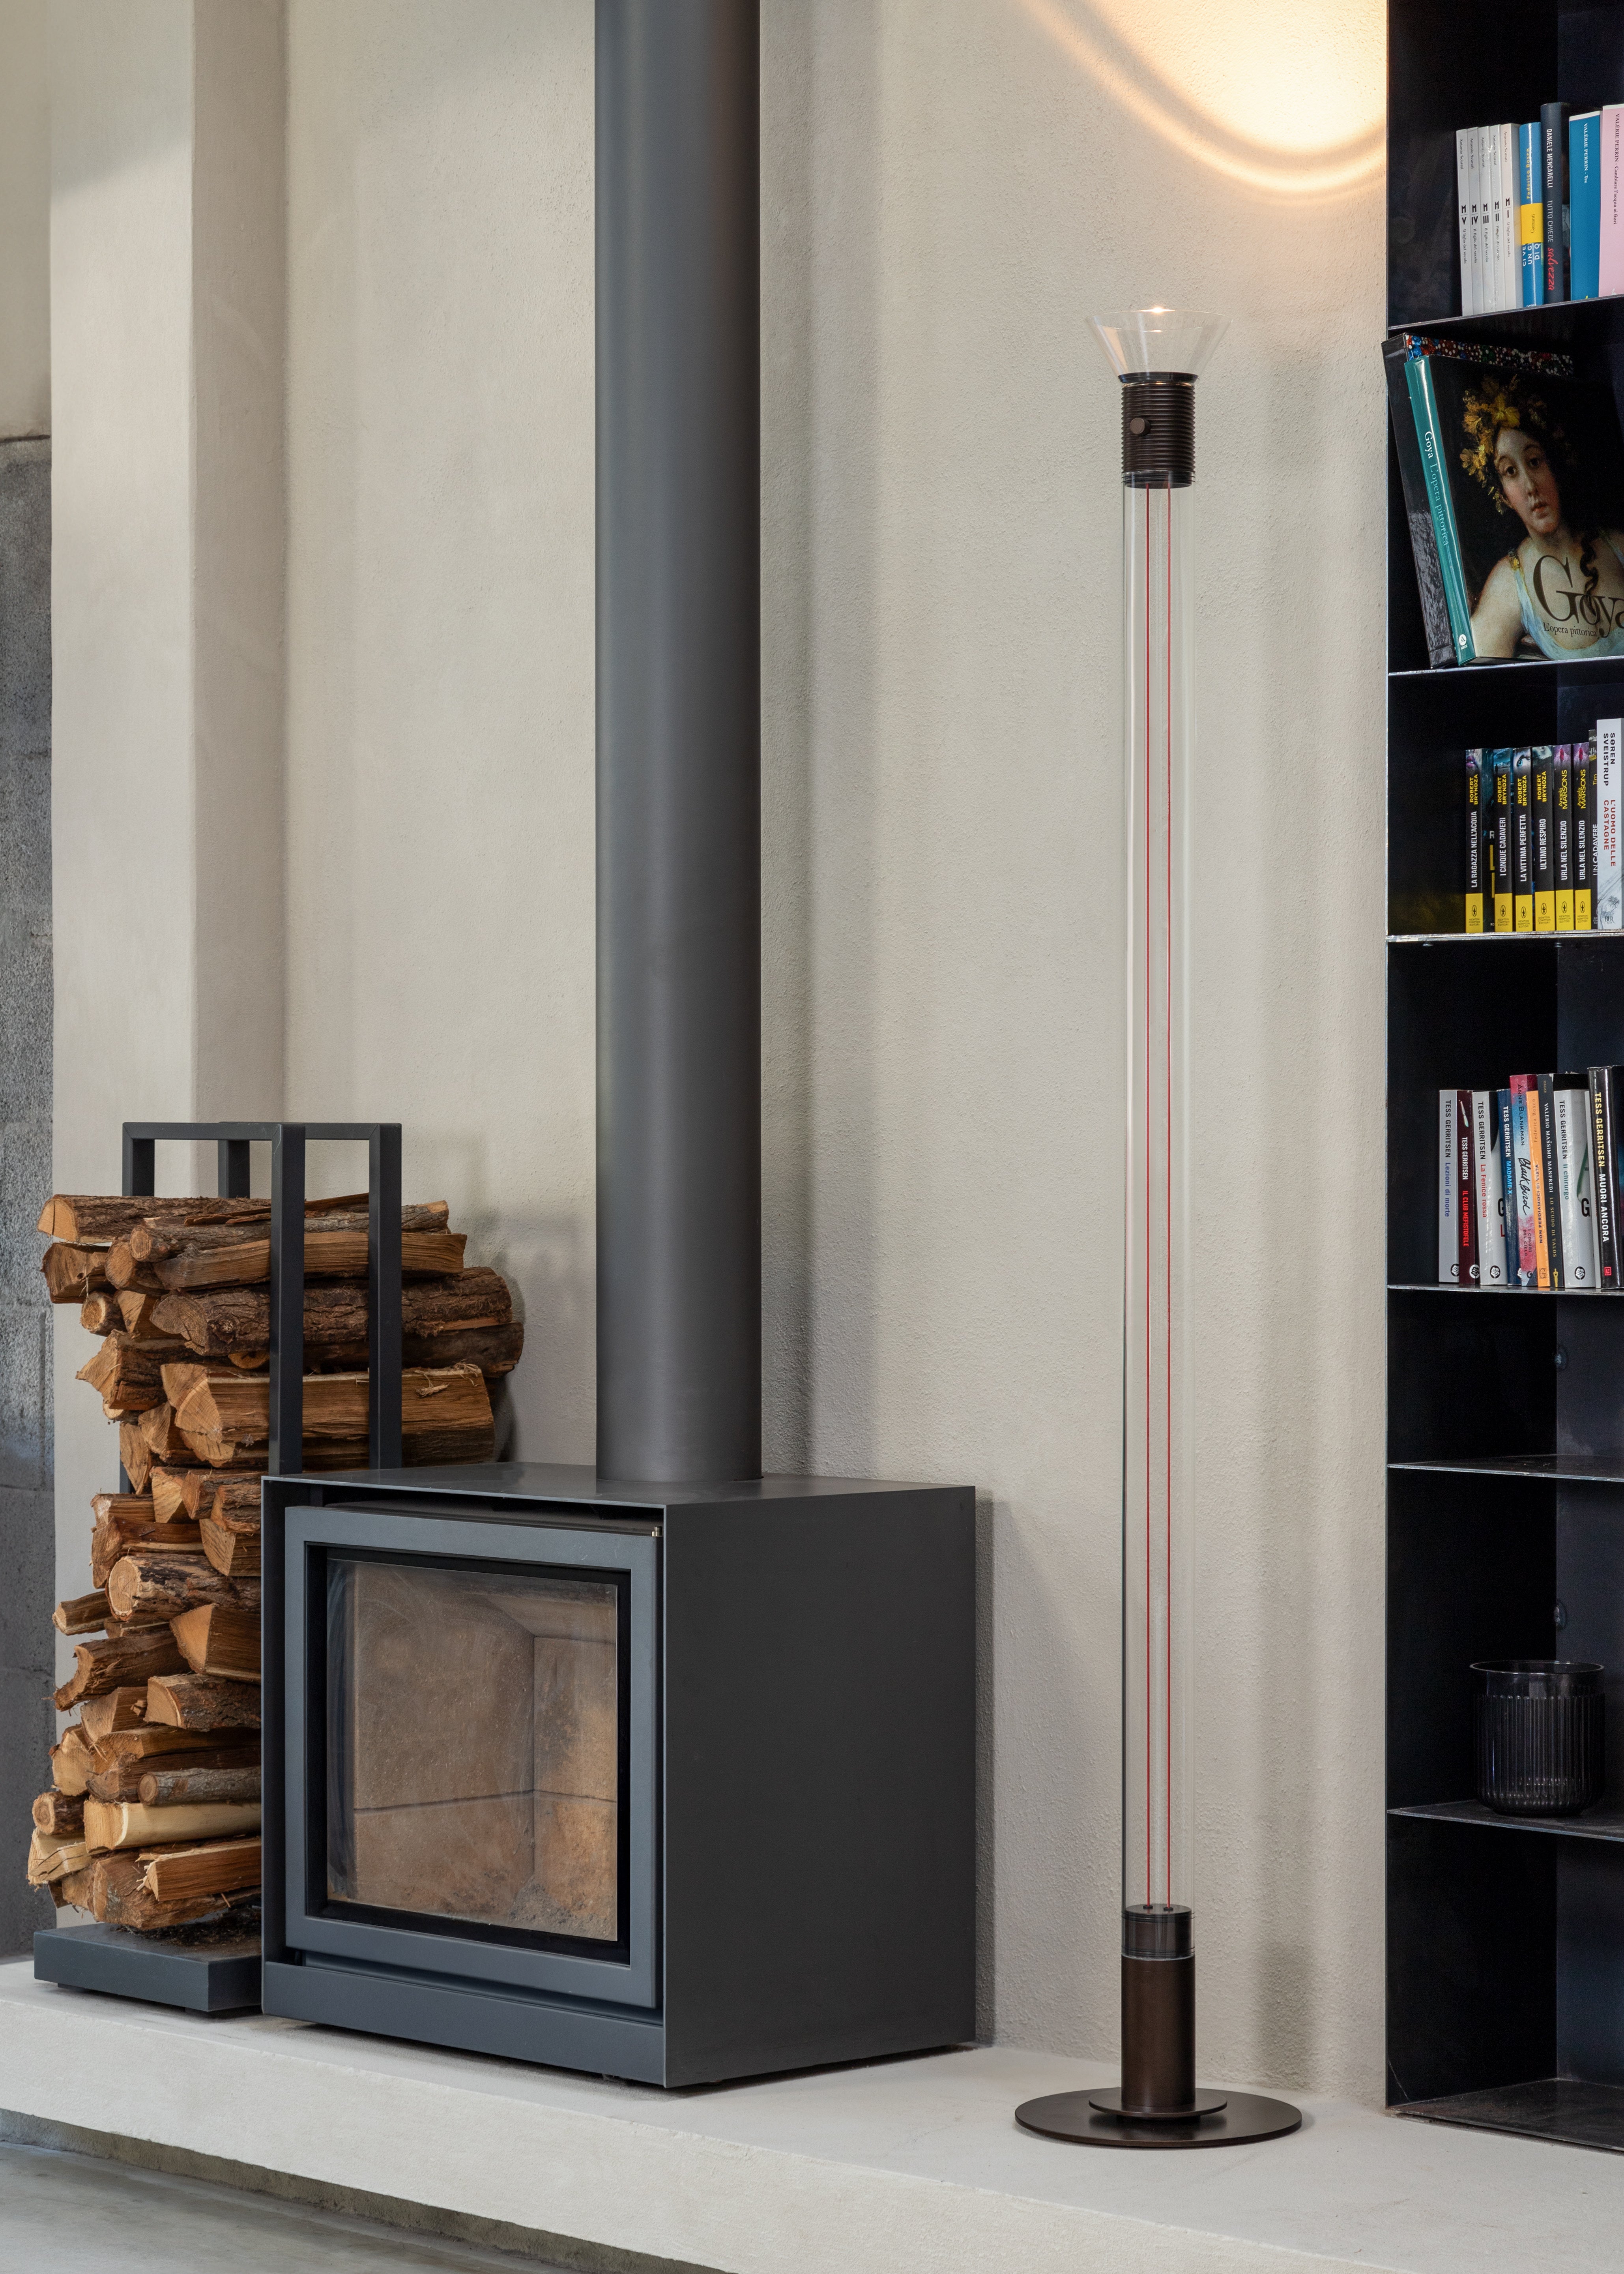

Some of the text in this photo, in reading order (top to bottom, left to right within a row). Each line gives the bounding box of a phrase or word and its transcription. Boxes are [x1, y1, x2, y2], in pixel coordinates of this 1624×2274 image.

[1495, 200, 1499, 210] M
[1506, 197, 1510, 206] M
[1461, 204, 1467, 214] M
[1472, 204, 1477, 213] M
[1483, 203, 1488, 212] M
[1461, 217, 1467, 225] V
[1471, 216, 1478, 225] IV
[1495, 213, 1499, 222] II
[1527, 254, 1532, 264] UN
[1534, 251, 1540, 260] DI
[1547, 247, 1559, 290] salvezza
[1425, 431, 1449, 546] Goya L'opera pittorica
[1543, 622, 1597, 637] L'opera pittorica
[1593, 865, 1598, 875] UN
[1520, 873, 1527, 882] LA
[1471, 879, 1478, 888] LA
[1596, 1118, 1605, 1167] GERRITSEN
[1599, 1173, 1607, 1203] MUORI
[1601, 1206, 1609, 1242] ANCORA
